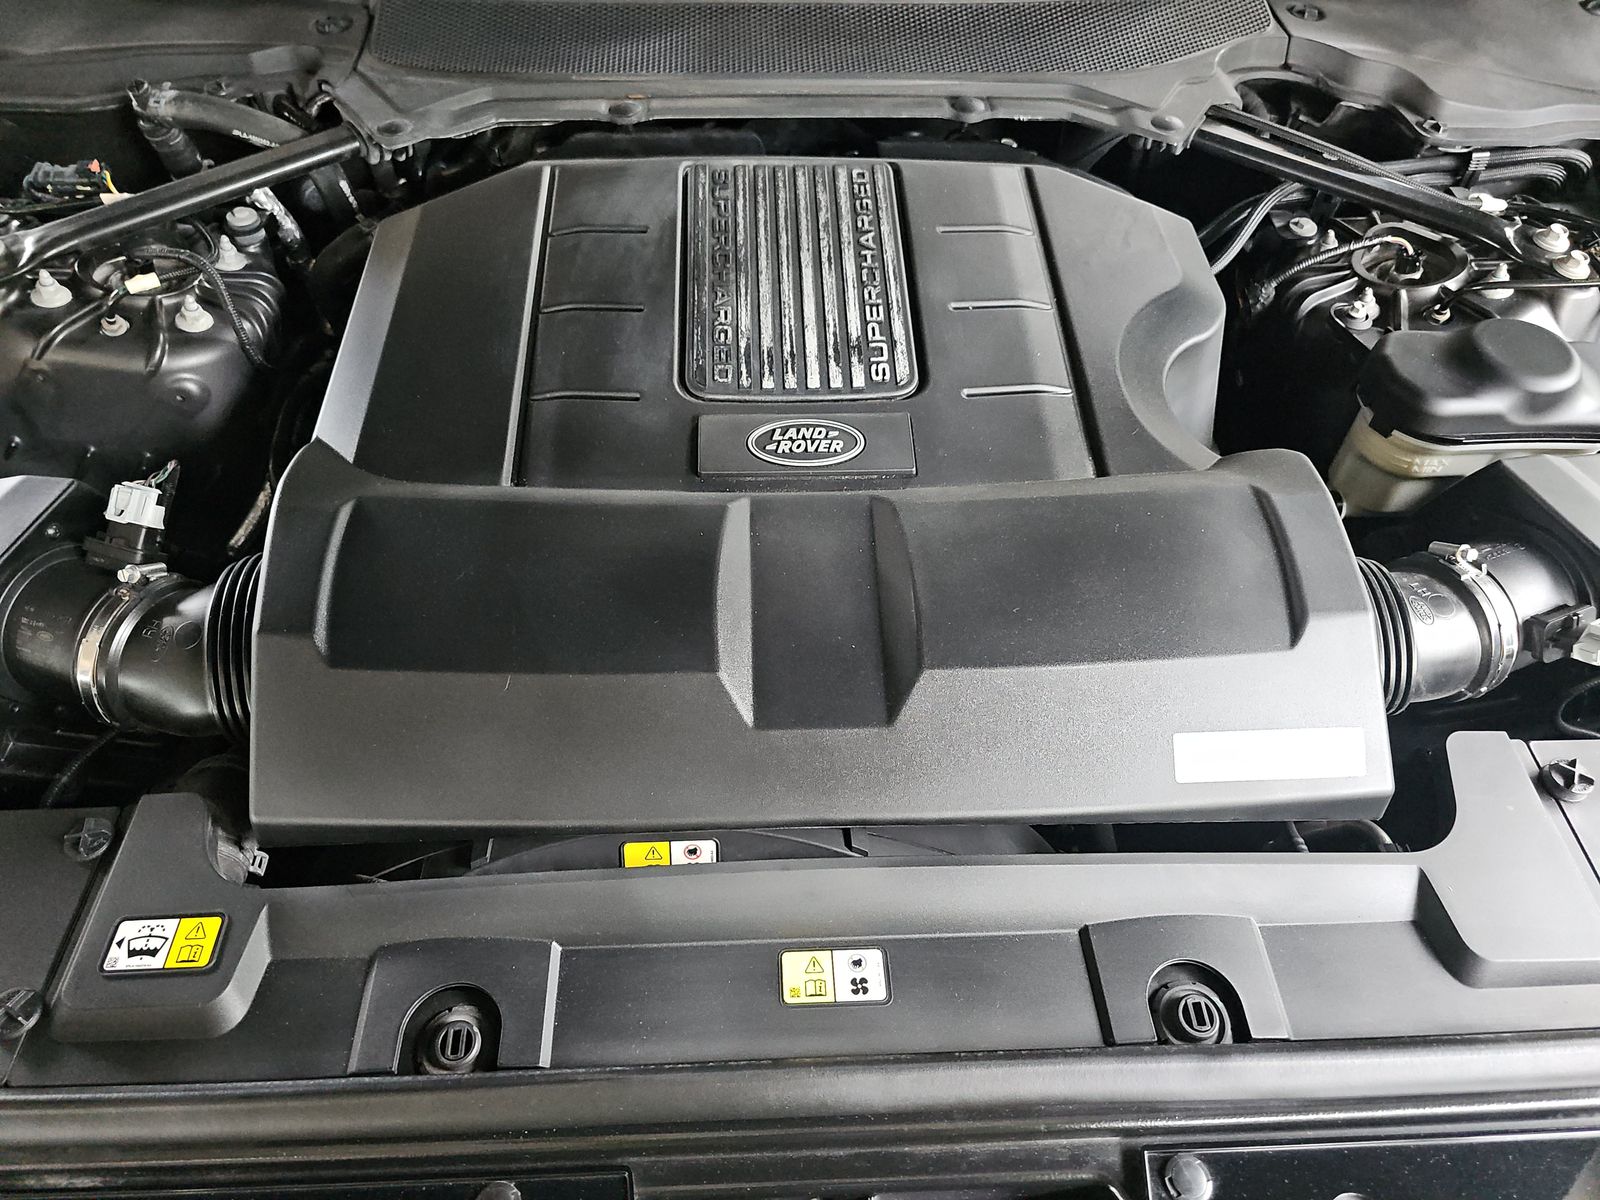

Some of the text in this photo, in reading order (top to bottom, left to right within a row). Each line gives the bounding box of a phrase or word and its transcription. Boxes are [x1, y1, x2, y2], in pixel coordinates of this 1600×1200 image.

[712, 169, 735, 384] SUPERCHARGED
[852, 168, 891, 383] SUPERCHARGED
[772, 427, 827, 441] LAND
[776, 440, 845, 454] ROVER
